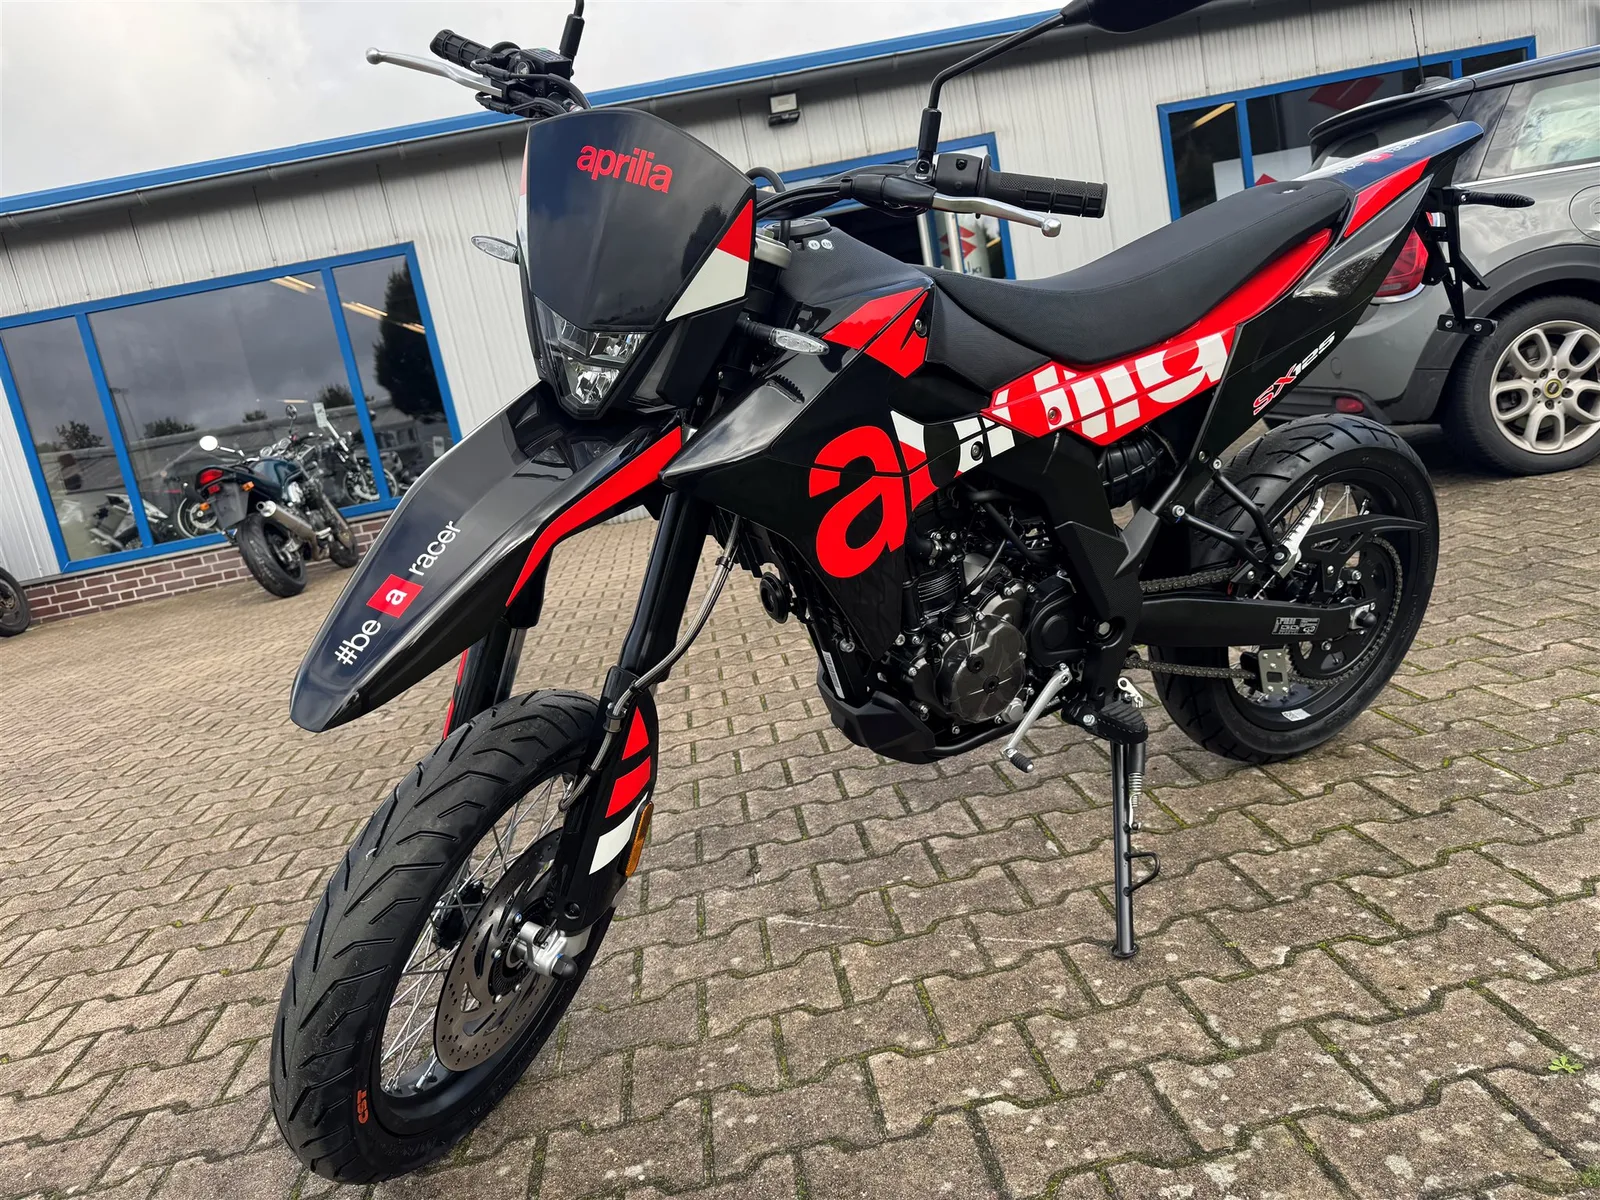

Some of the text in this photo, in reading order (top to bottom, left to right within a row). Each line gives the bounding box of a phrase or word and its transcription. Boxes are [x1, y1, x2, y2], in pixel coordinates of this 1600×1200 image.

[576, 145, 673, 194] aprilia
[334, 520, 462, 665] #be a racer
[357, 1090, 369, 1124] CST
